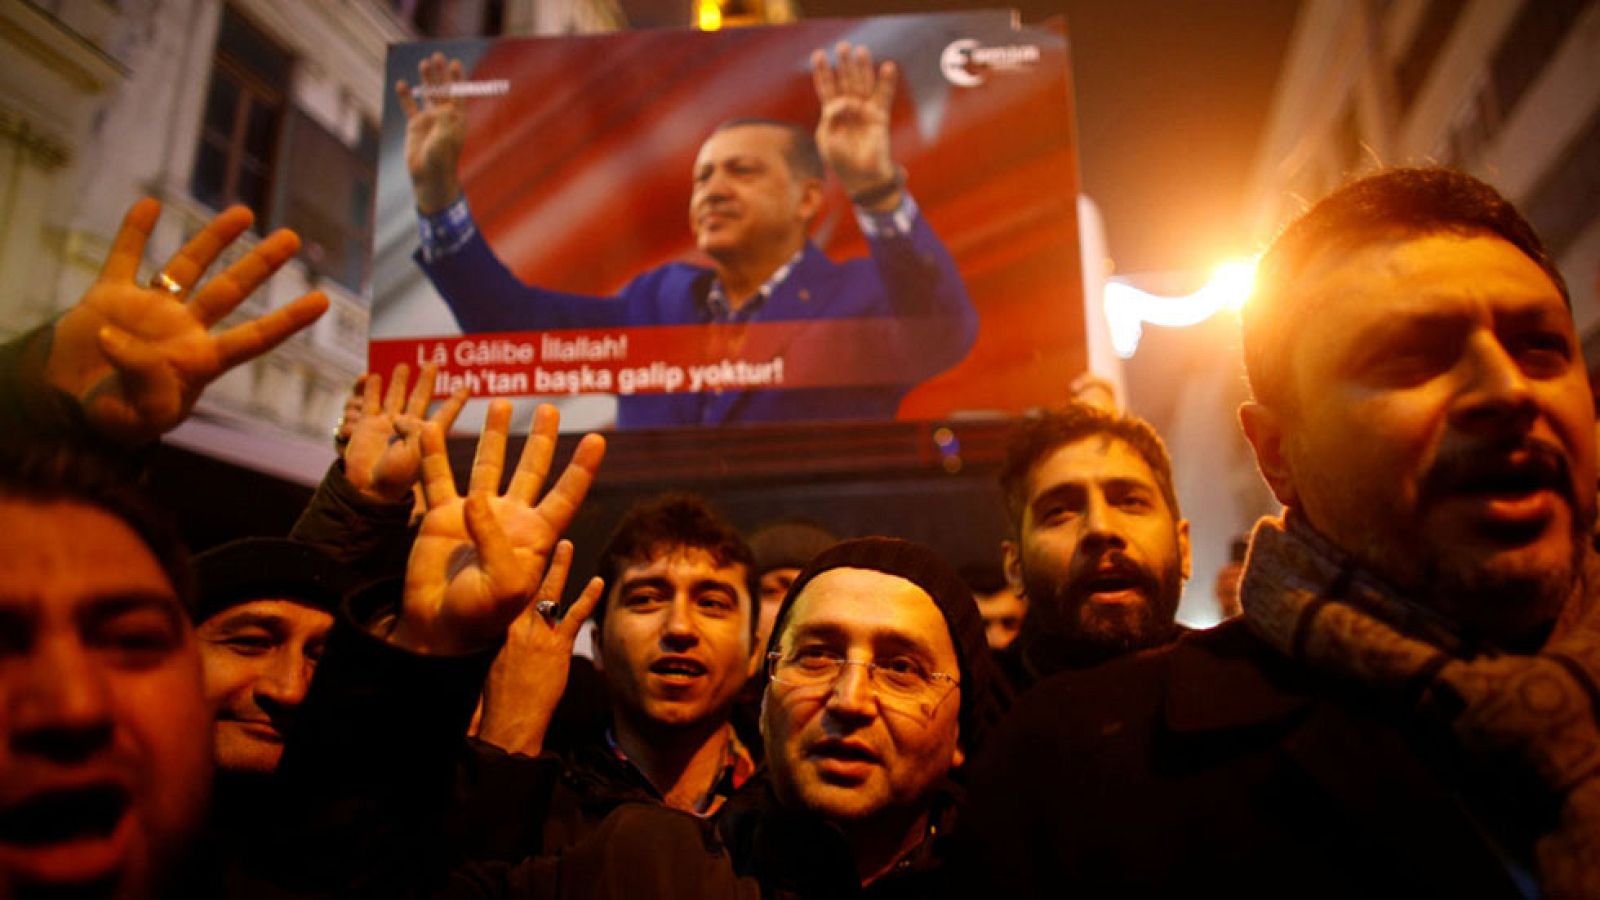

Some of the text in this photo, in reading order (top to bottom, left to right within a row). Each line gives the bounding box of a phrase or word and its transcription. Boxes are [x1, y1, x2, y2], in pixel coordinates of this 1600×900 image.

[417, 343, 447, 367] Lâ
[454, 340, 534, 366] Gâlibe
[422, 356, 784, 394] llah'tan başka galip yoktur!
